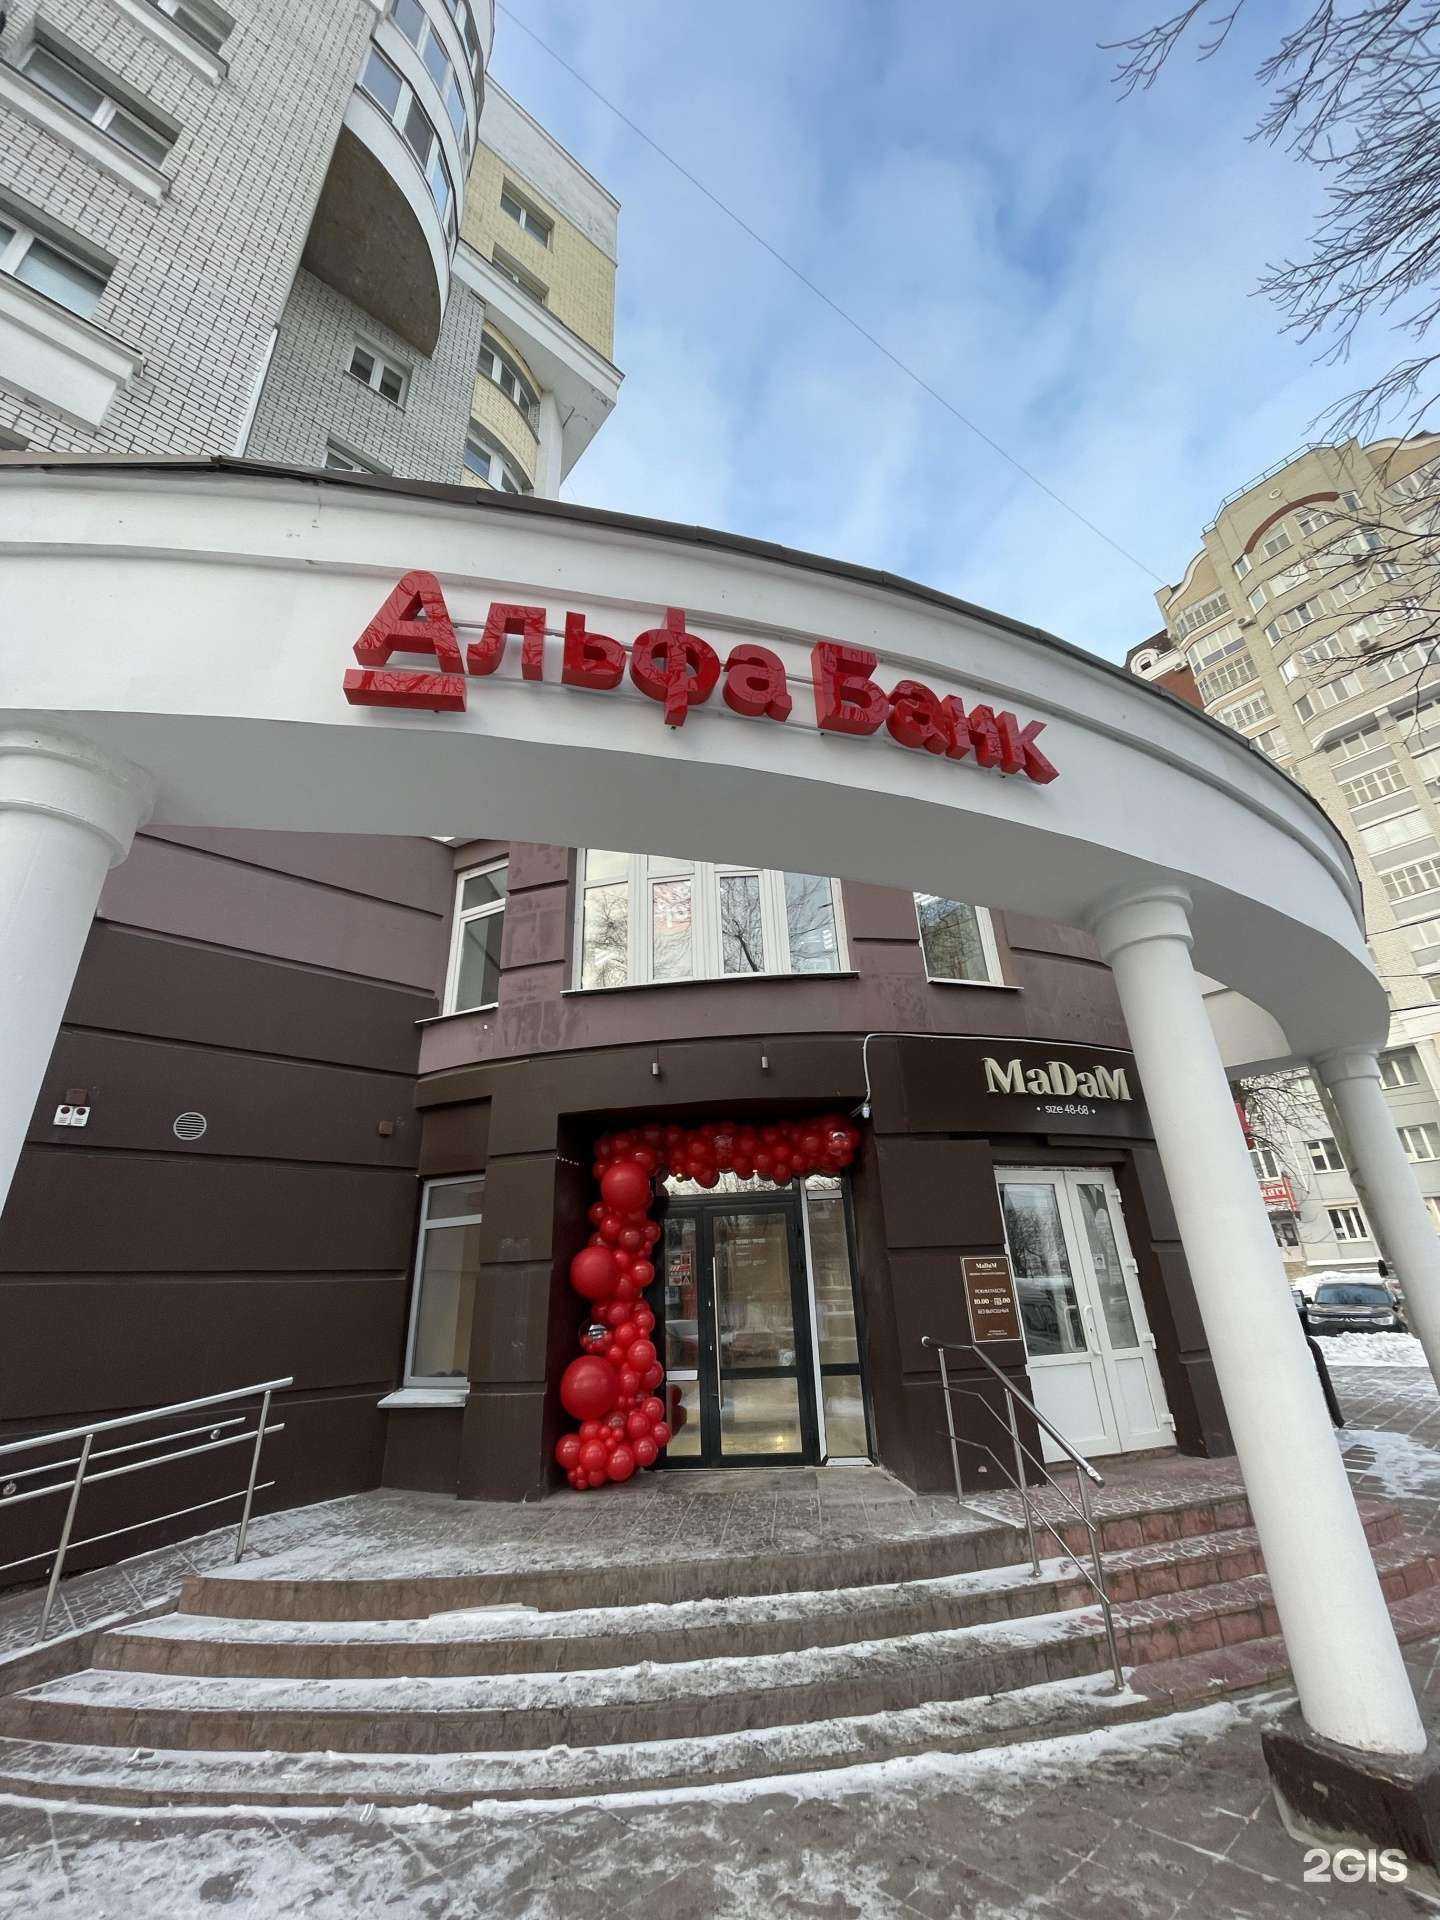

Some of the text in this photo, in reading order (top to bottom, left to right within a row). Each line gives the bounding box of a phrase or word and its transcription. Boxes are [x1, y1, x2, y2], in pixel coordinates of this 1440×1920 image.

[344, 570, 1060, 785] Альфа Банк
[981, 1057, 1134, 1101] MaDaM
[1044, 1104, 1089, 1116] size 48-68
